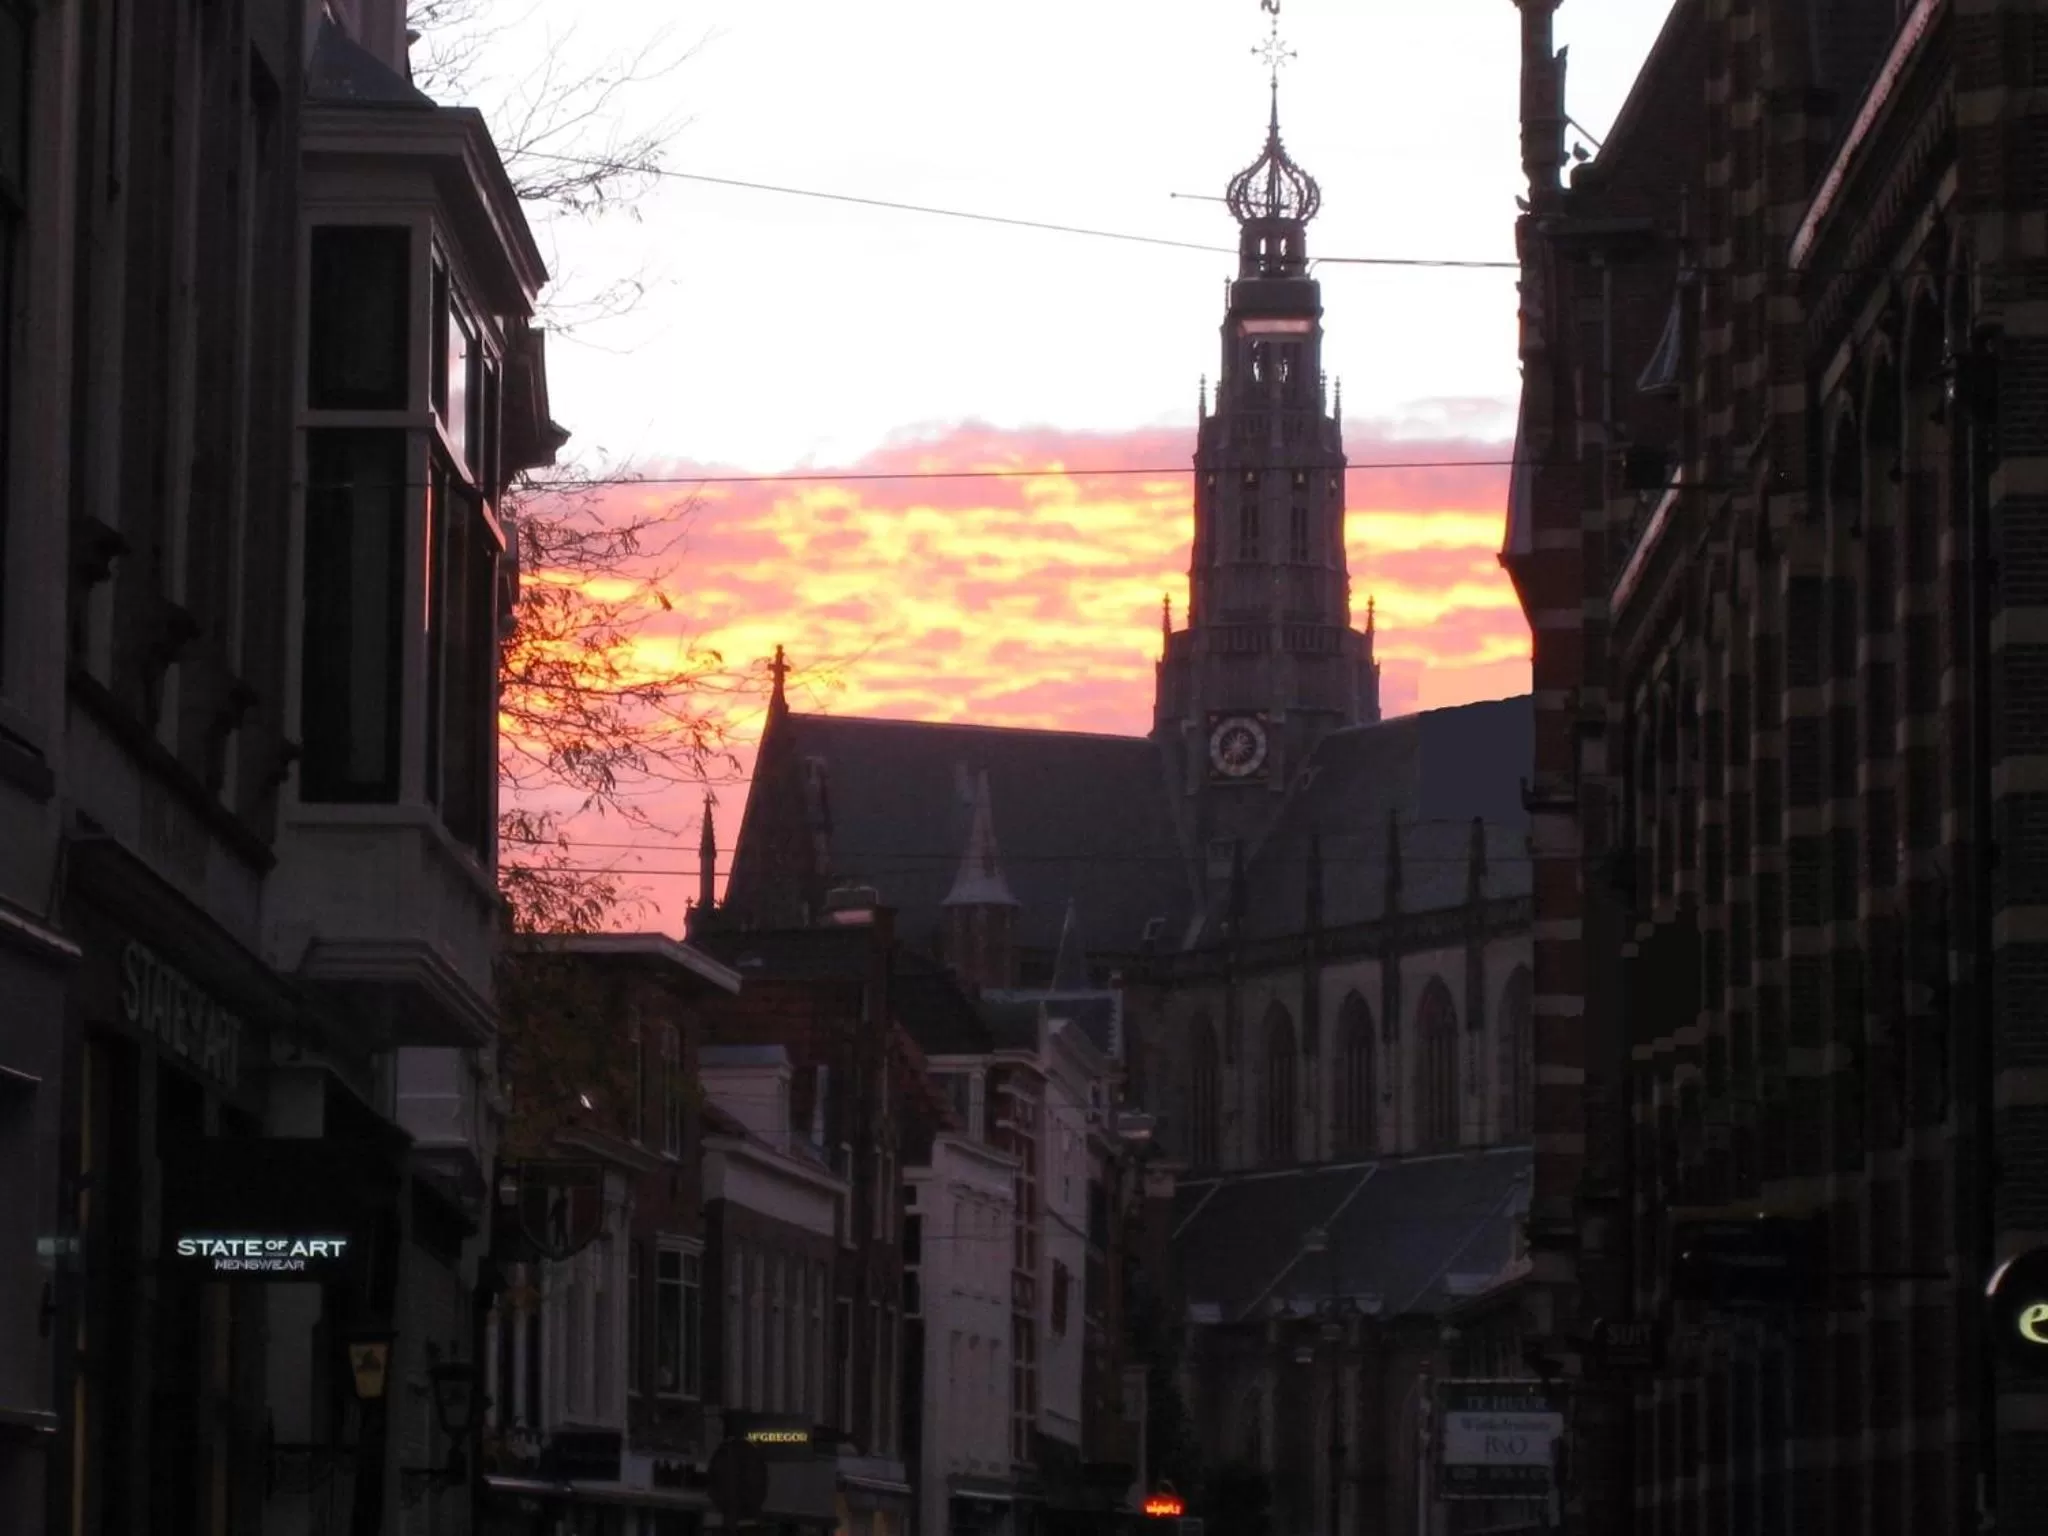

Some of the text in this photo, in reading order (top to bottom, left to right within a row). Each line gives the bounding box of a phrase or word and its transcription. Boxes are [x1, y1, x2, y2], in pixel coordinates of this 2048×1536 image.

[177, 1239, 346, 1257] STATE OF ART
[215, 1259, 305, 1271] MENSWEAR
